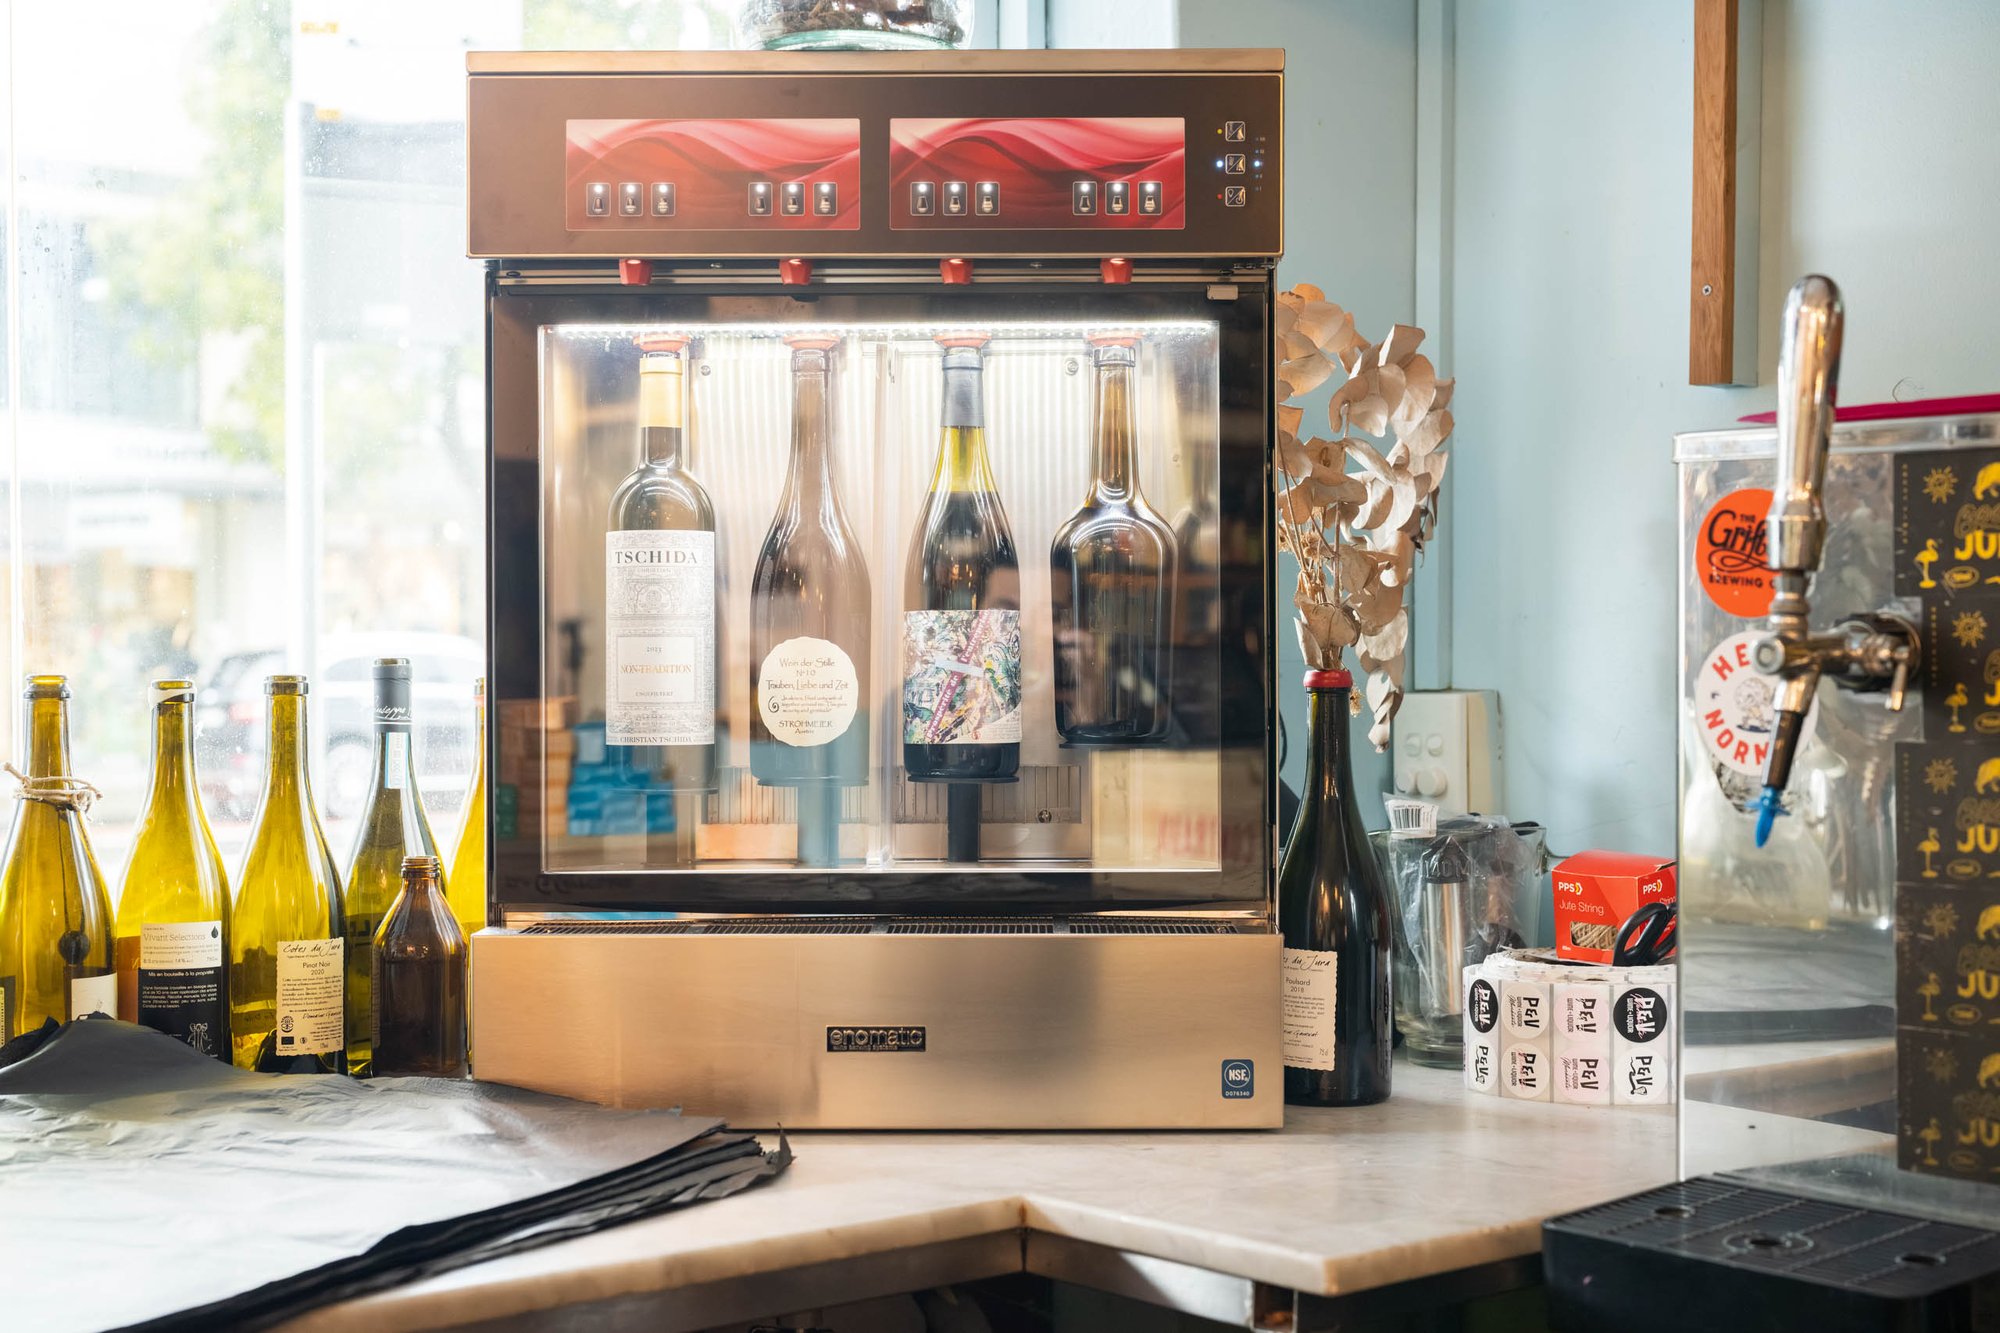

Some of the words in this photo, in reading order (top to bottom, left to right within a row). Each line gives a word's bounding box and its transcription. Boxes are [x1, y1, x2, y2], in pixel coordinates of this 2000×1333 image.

[1740, 514, 1755, 522] THE
[1708, 510, 1766, 556] Grift
[1955, 529, 2000, 560] JU
[615, 550, 698, 564] TSCHIDA
[1709, 574, 1763, 588] BREWING
[620, 664, 692, 674] NON-TRADITION
[801, 658, 812, 666] der
[796, 680, 817, 690] Liebe
[819, 680, 833, 689] und
[835, 680, 848, 690] Zeit
[778, 720, 833, 728] STROHMEIER
[620, 736, 658, 744] CHRISTIAN
[1957, 823, 2000, 853] JU
[1558, 882, 1574, 892] PPS
[1643, 883, 1656, 894] PPS
[1559, 900, 1576, 911] Jute
[1578, 901, 1604, 916] String
[1286, 977, 1311, 986] Poulsard
[1523, 996, 1539, 1029] P&V
[1576, 998, 1596, 1034] P&V
[1636, 997, 1656, 1033] P&V
[830, 1027, 922, 1046] enomatic
[1479, 1046, 1488, 1076] P&V
[1229, 1069, 1246, 1081] NSF
[1518, 1052, 1536, 1088] P&V
[1580, 1058, 1598, 1090] P&V
[1636, 1056, 1652, 1086] P&V
